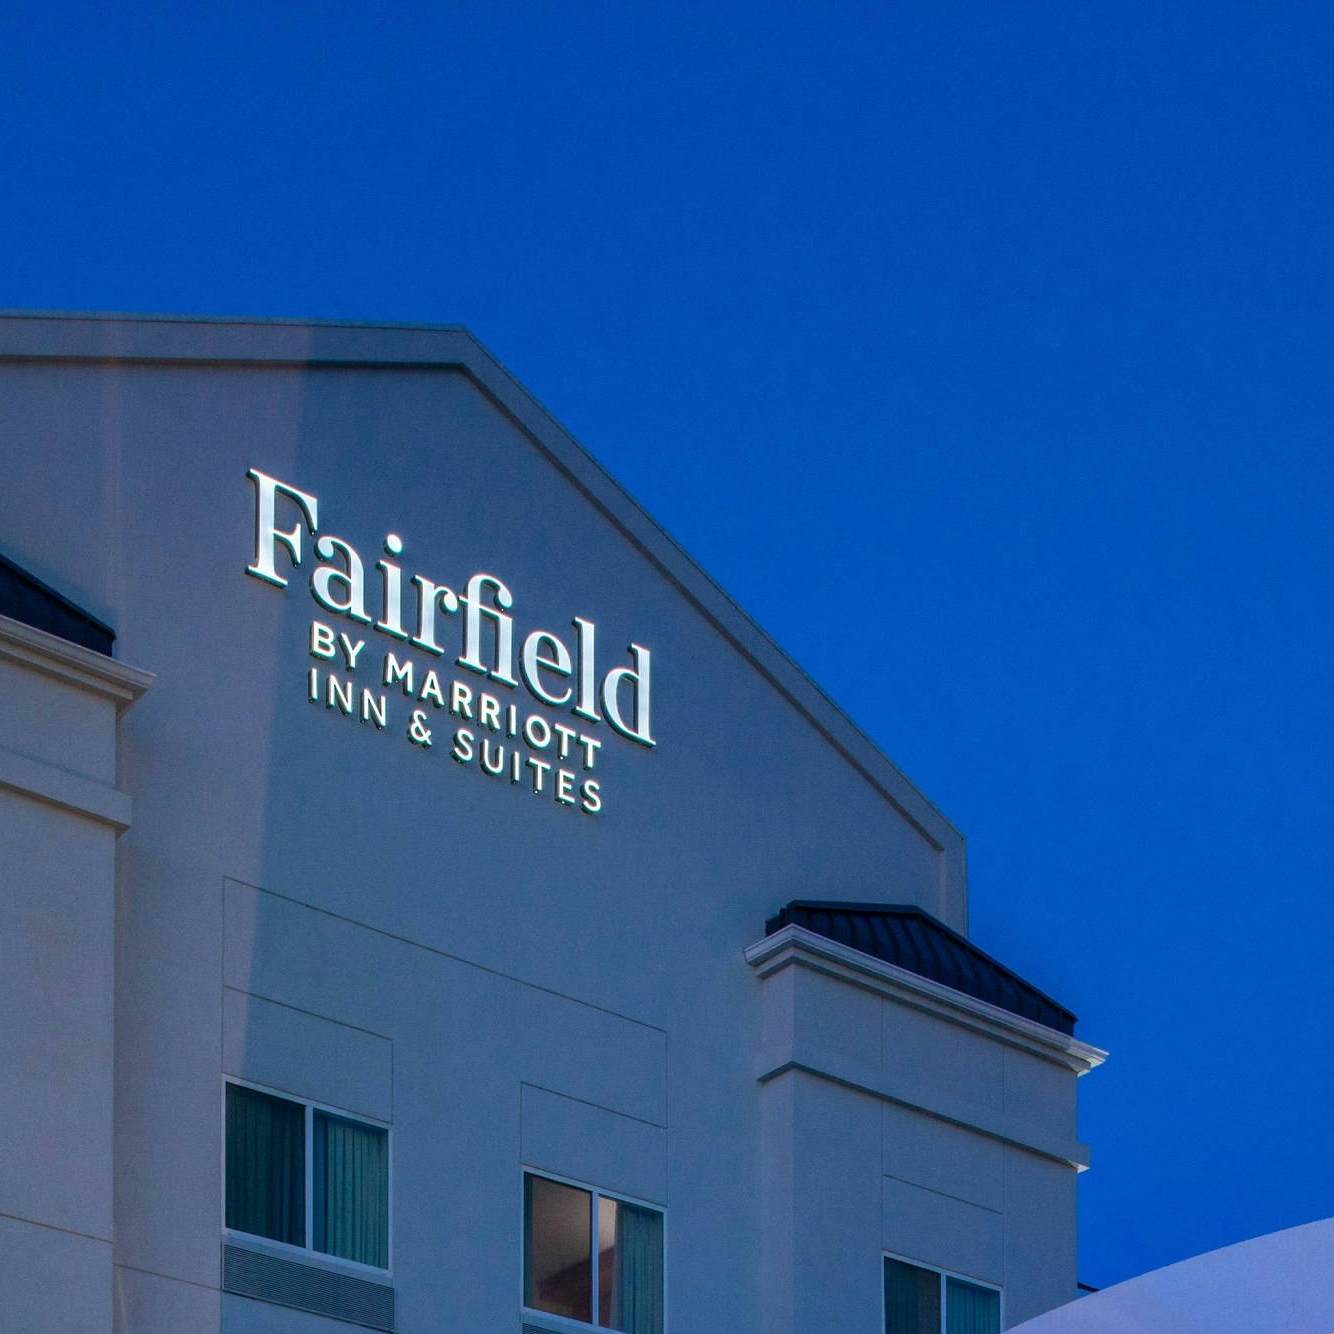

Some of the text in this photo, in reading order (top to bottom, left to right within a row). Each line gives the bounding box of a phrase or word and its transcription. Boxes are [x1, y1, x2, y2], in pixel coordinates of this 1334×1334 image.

[245, 468, 656, 747] Fairfield
[309, 668, 602, 814] INN & SUITES
[311, 621, 601, 770] BY MARRIOTT
